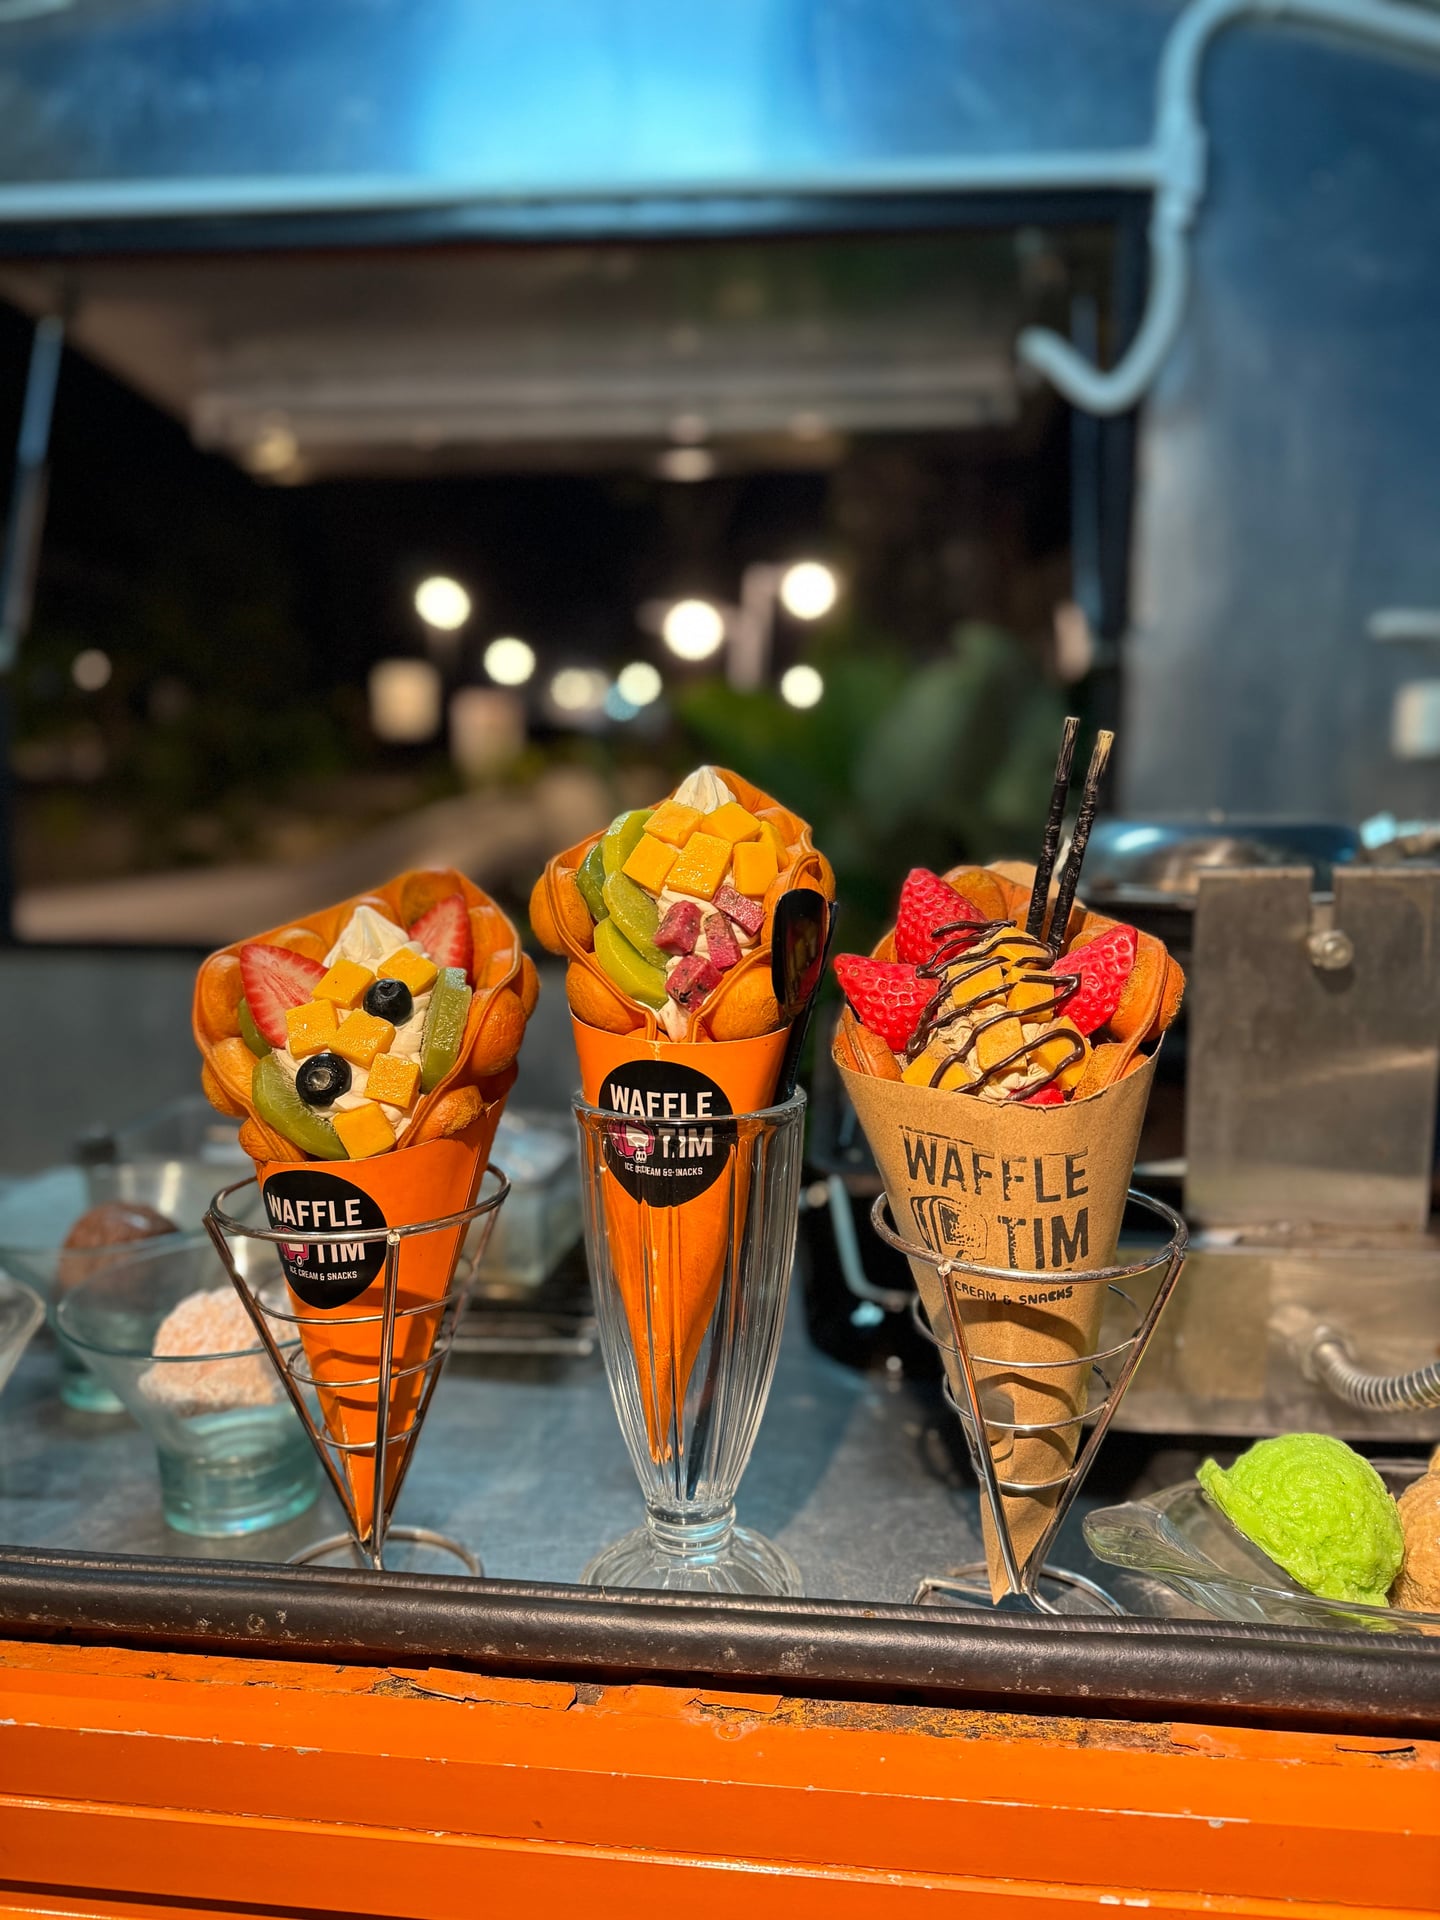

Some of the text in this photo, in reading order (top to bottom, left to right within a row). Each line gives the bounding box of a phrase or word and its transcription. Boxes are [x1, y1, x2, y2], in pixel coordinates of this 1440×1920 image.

[610, 1083, 713, 1118] WAFFLE
[659, 1127, 713, 1158] TIM
[624, 1162, 634, 1173] ICE
[902, 1131, 1089, 1203] WAFFLE
[267, 1192, 362, 1227] WAFFLE
[997, 1207, 1089, 1269] TIM
[289, 1265, 358, 1281] ICE CREAM & SNACKS
[954, 1280, 1073, 1306] CREAM & SNACKS
